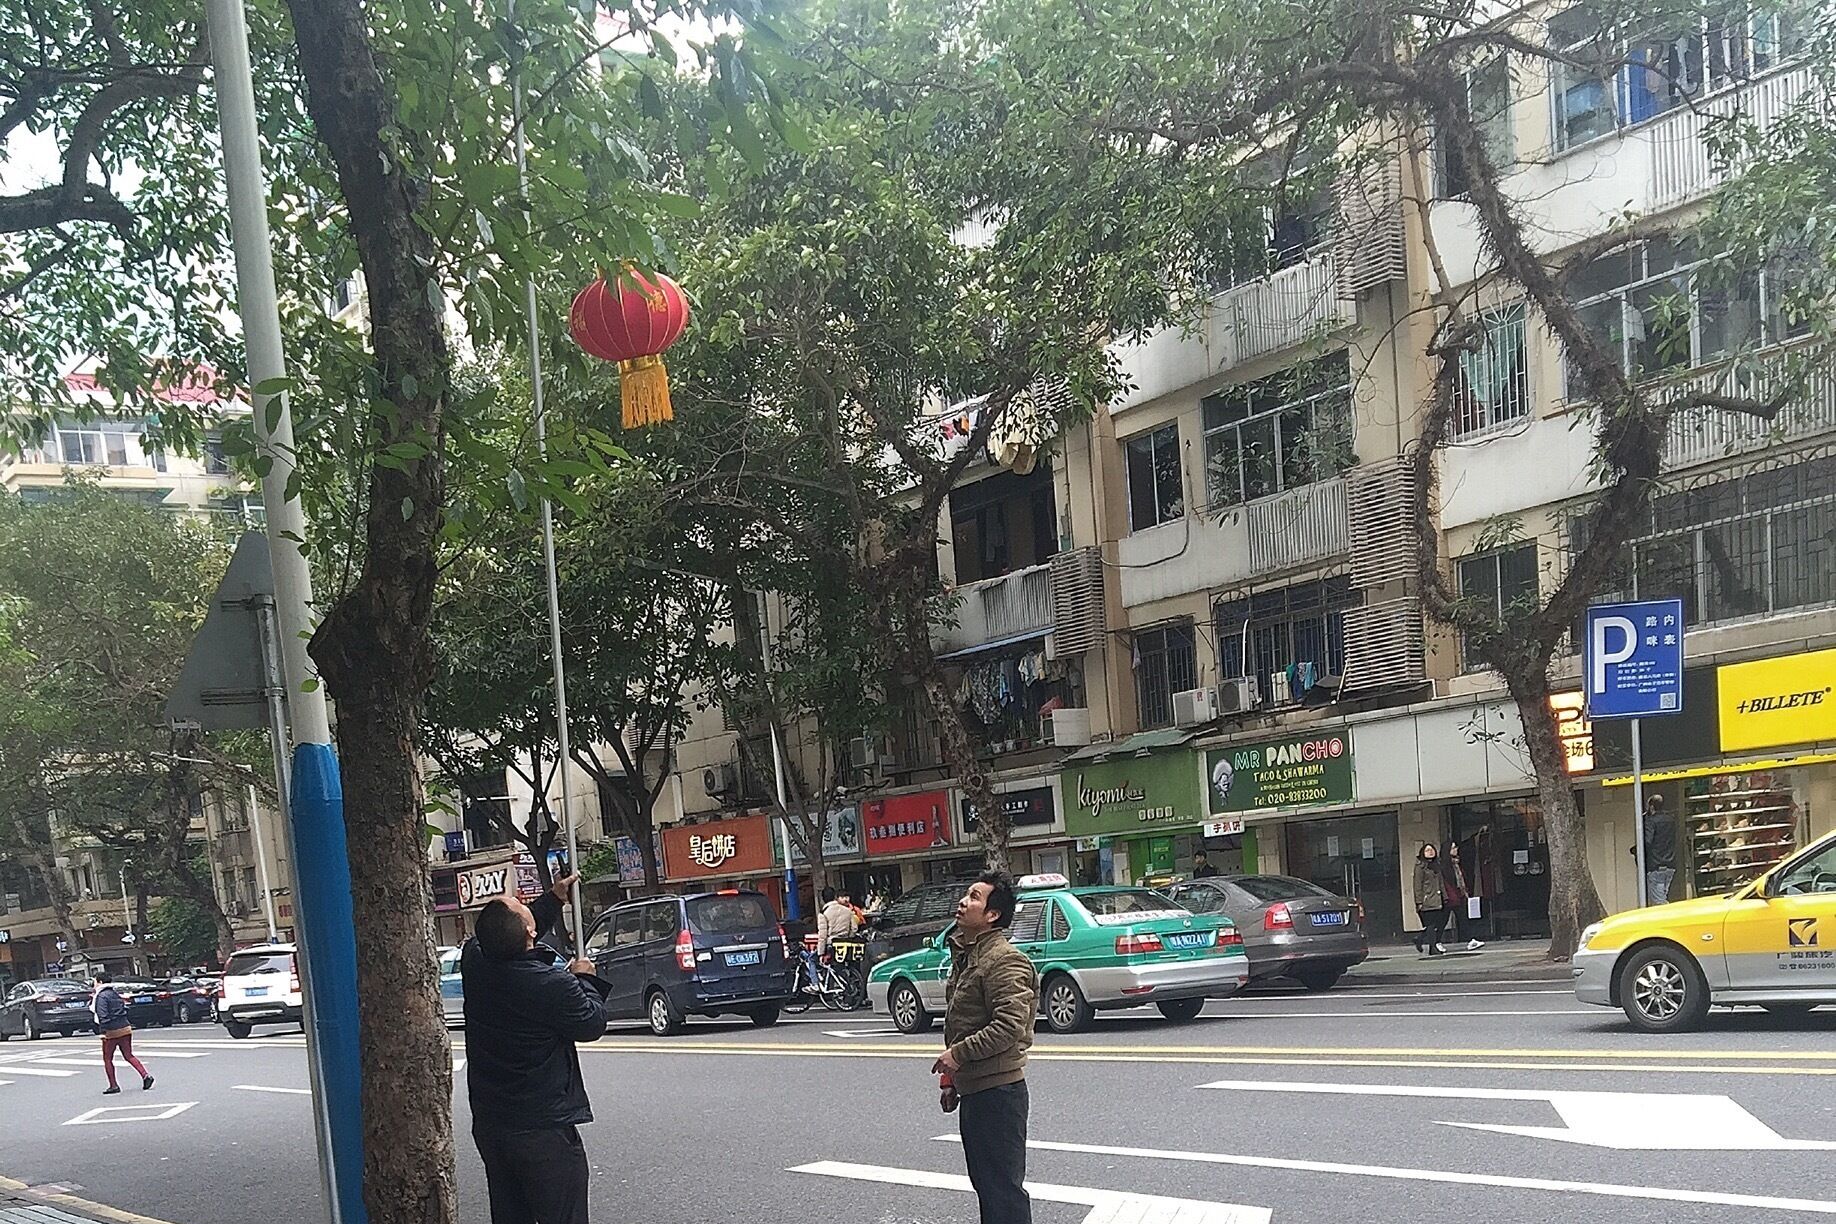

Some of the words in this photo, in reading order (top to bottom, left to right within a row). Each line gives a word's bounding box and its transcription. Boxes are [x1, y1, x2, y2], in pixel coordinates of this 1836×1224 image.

[1594, 616, 1637, 694] P
[1234, 749, 1261, 771] MR
[1266, 737, 1343, 768] PANCHO
[1253, 769, 1275, 783] TACO
[1282, 764, 1325, 782] SHAWARMA
[1267, 787, 1327, 804] 020-83833200
[688, 834, 736, 864] 皇后饼店
